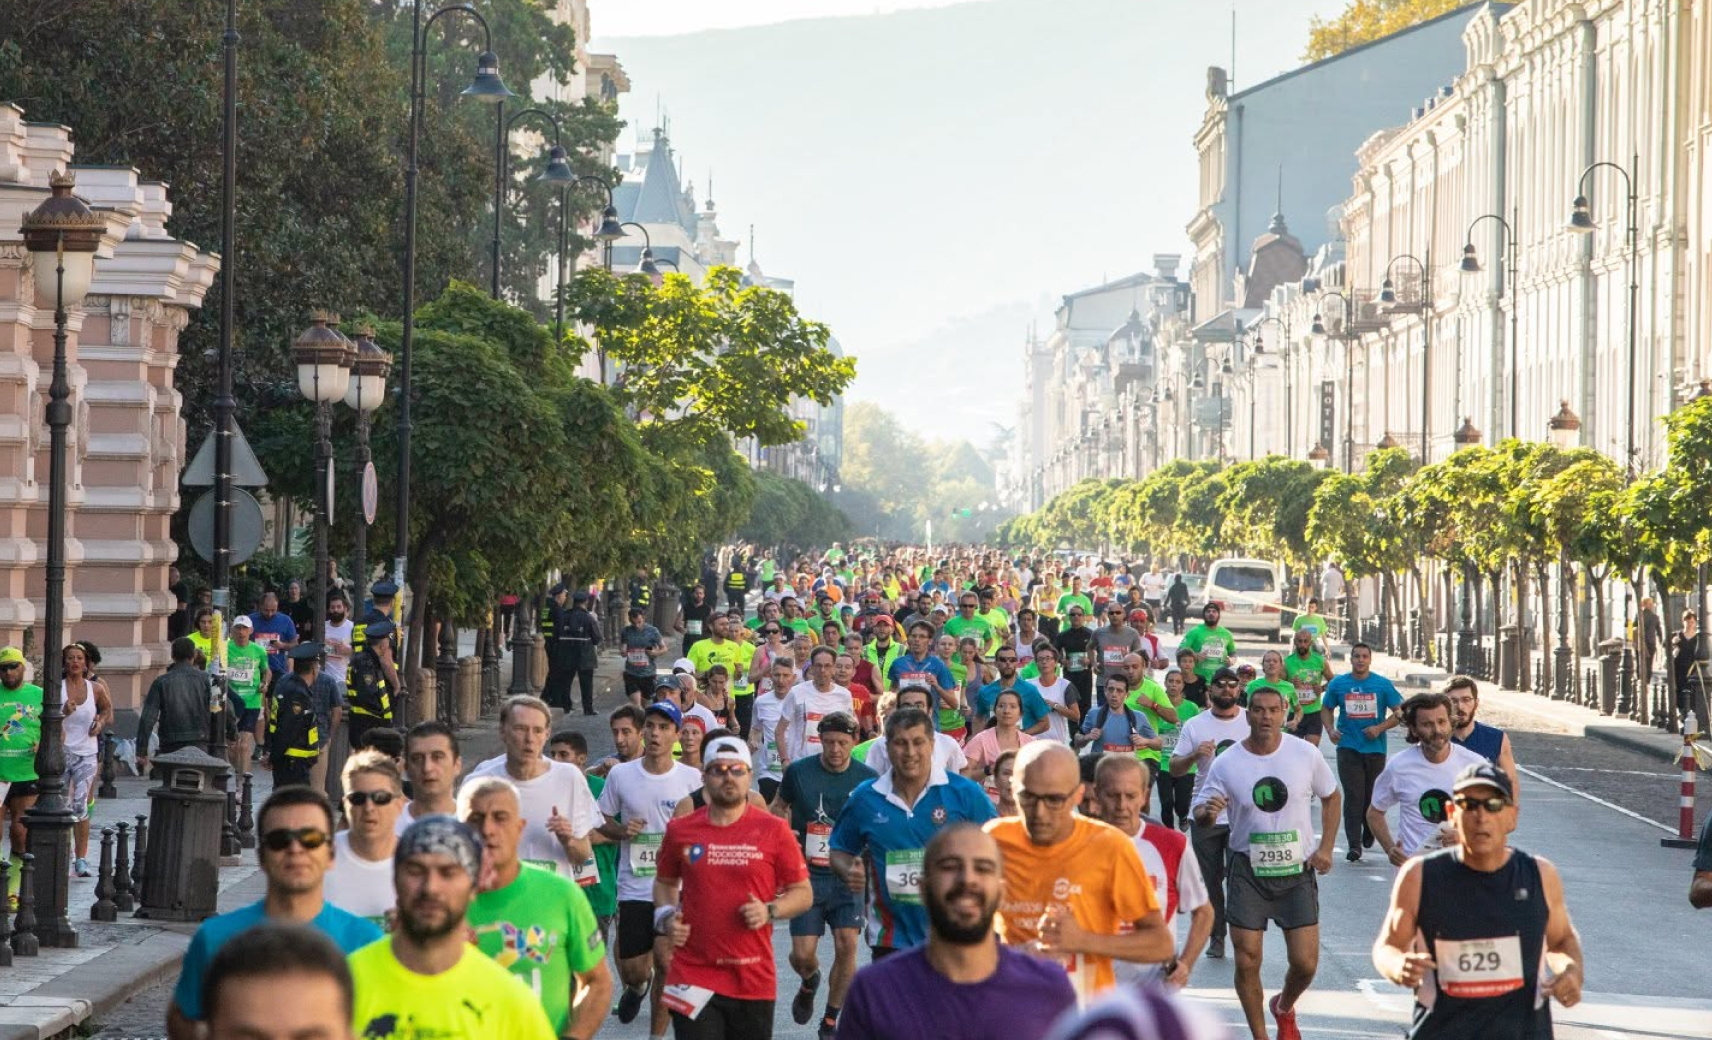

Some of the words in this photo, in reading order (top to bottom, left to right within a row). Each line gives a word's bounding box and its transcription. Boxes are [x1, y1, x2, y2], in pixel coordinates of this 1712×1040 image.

[1324, 384, 1332, 440] HOTEL
[1353, 703, 1368, 711] 791
[639, 850, 657, 862] 41
[1259, 849, 1293, 862] 2938
[1459, 952, 1501, 972] 629
